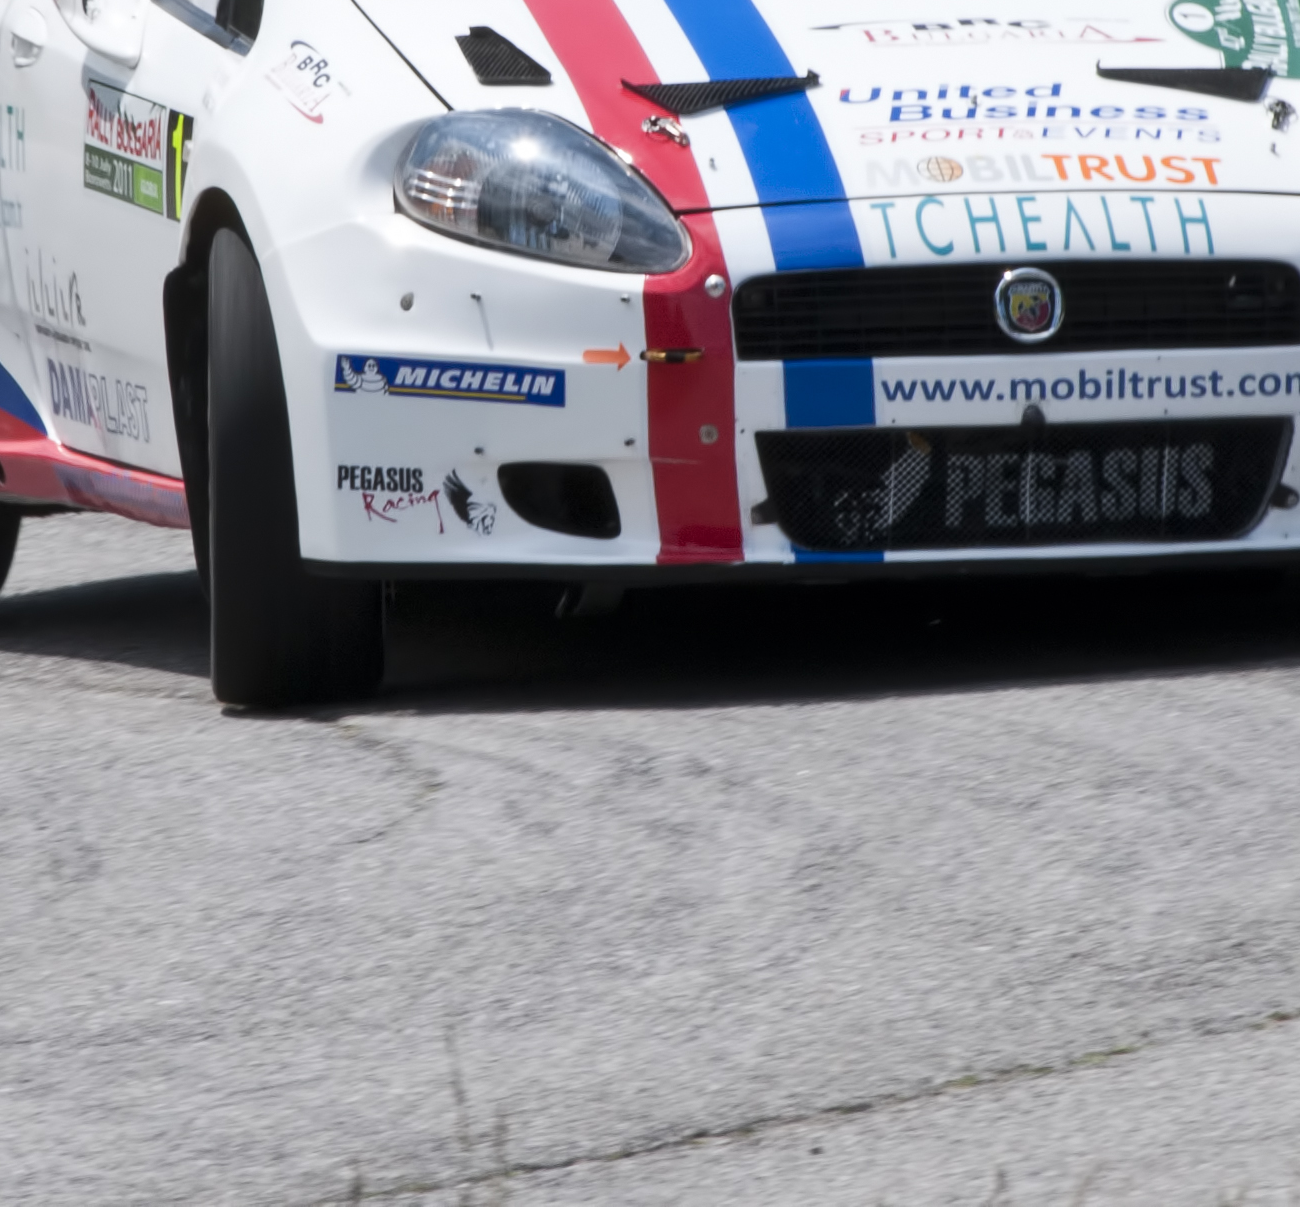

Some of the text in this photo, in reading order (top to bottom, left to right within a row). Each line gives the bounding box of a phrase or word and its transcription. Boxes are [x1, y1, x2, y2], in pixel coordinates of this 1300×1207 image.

[296, 55, 331, 89] BRC
[839, 83, 1062, 104] United
[86, 87, 115, 147] RALLY
[888, 103, 1210, 123] Business
[113, 159, 133, 201] 2011
[394, 366, 555, 396] MICHELIN
[337, 465, 424, 493] PEGASUS
[943, 442, 1215, 528] PEGASUS
[362, 489, 445, 534] Racing
